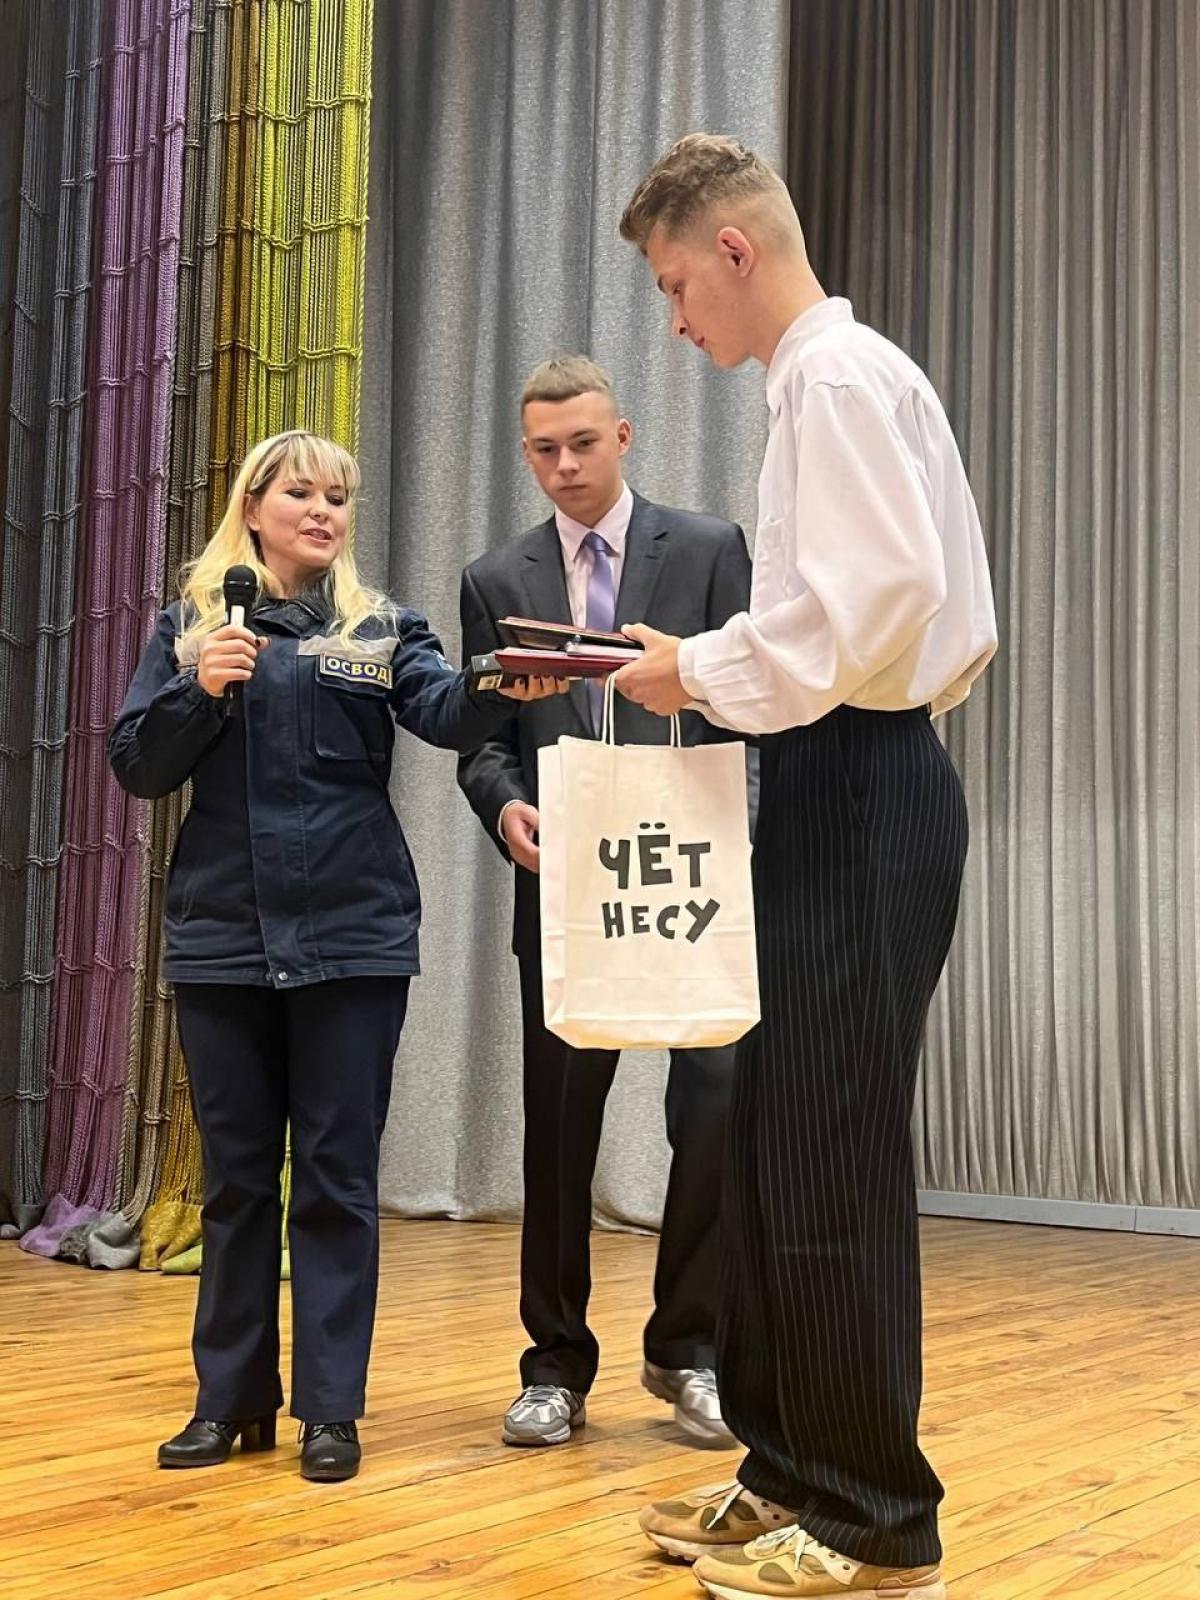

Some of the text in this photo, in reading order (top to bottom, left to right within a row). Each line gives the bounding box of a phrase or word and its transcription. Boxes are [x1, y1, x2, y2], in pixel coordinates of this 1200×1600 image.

[326, 657, 388, 683] ОСВОД
[598, 822, 711, 890] ЧЁТ
[601, 898, 720, 944] НЕСУ
